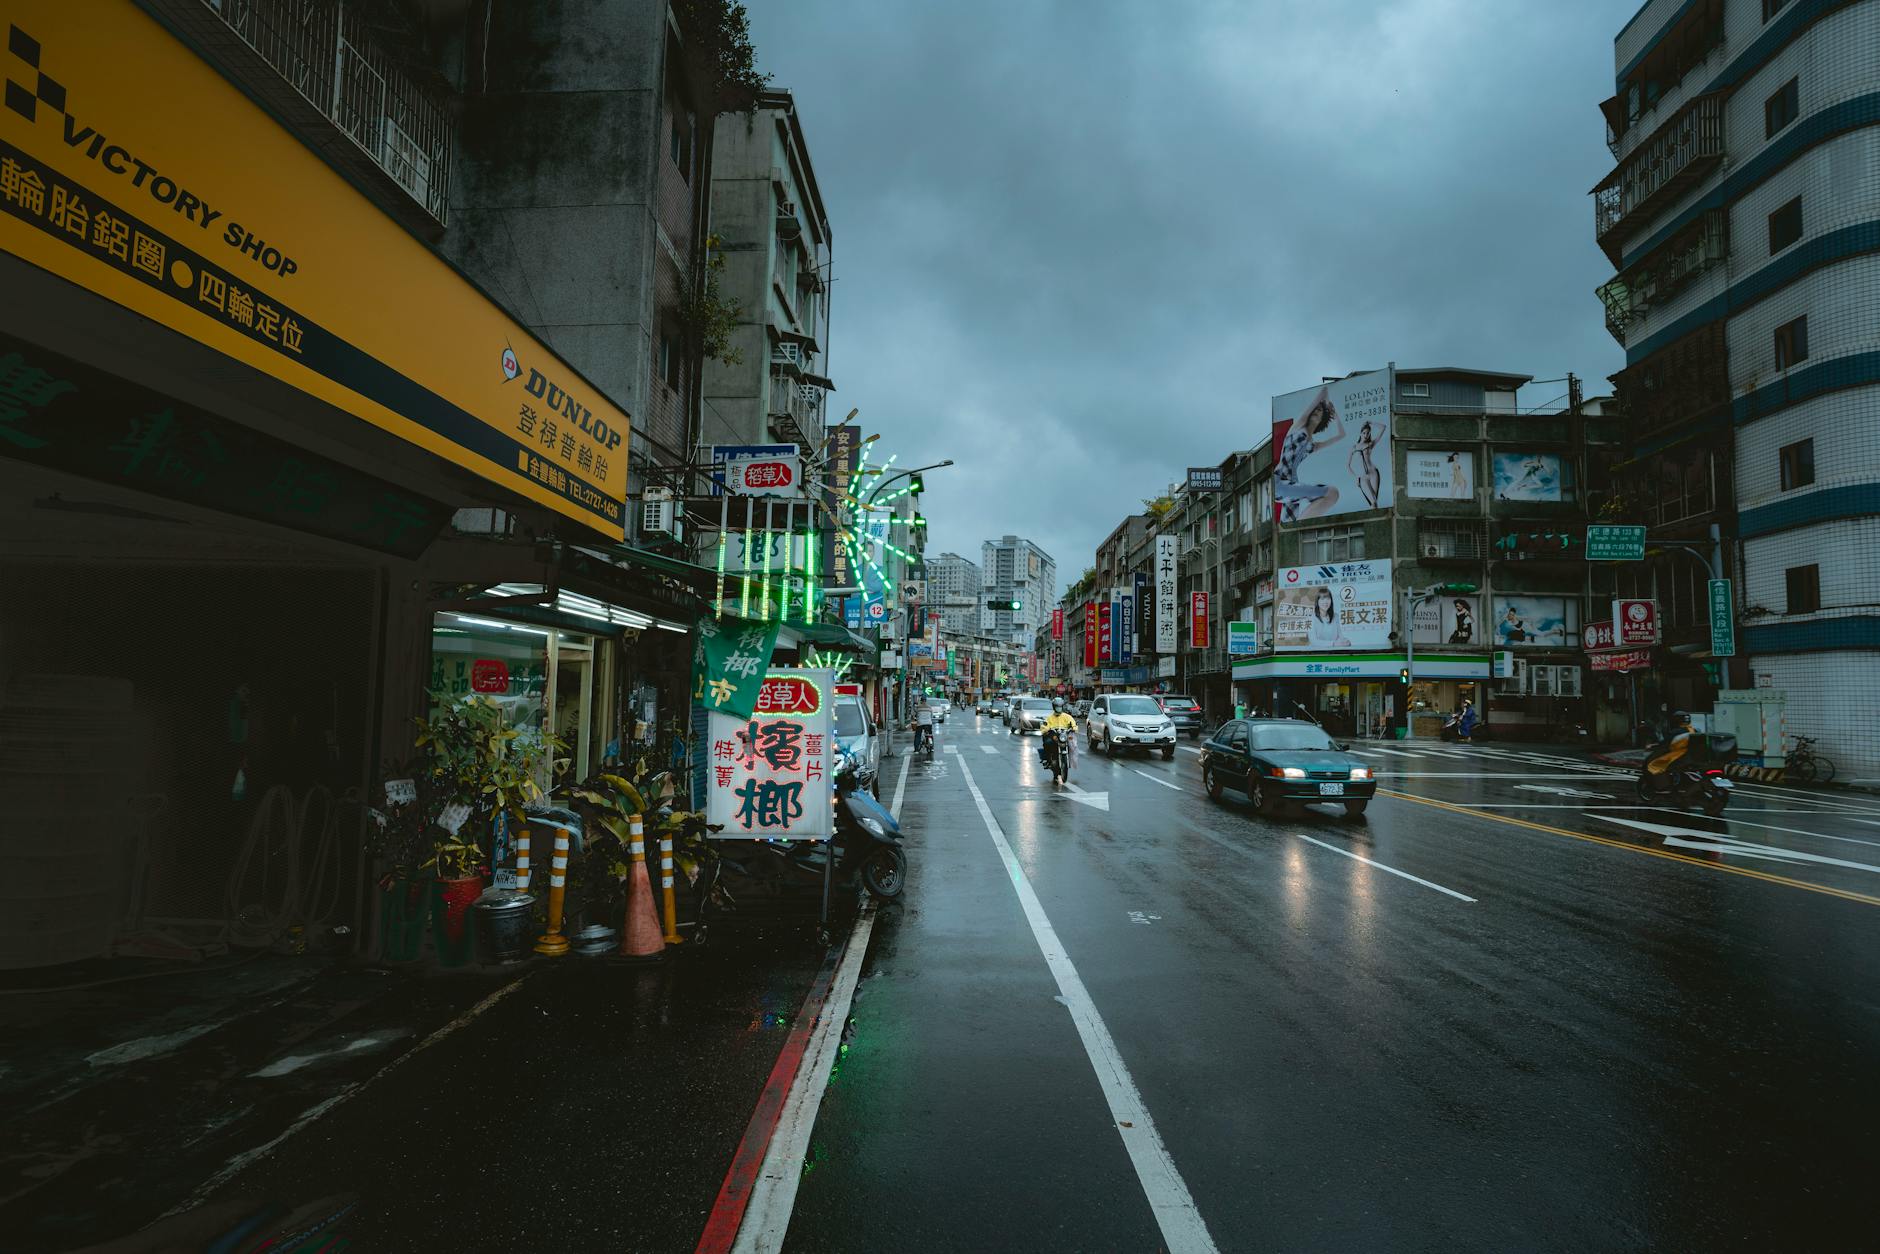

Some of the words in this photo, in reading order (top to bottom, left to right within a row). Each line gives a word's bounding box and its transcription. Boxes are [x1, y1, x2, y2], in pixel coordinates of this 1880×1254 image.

[64, 112, 223, 230] VICTORY
[223, 222, 298, 279] SHOP
[198, 269, 304, 354] 四輪定位
[524, 367, 621, 451] DUNLOP
[1344, 386, 1385, 402] LOLINYA
[747, 465, 789, 486] 稻草人
[871, 606, 882, 615] 12
[1160, 539, 1174, 637] 北平餡餅粥
[1341, 608, 1388, 625] 張文潔
[1325, 666, 1360, 674] FamilyMart
[734, 720, 805, 829] 檳榔
